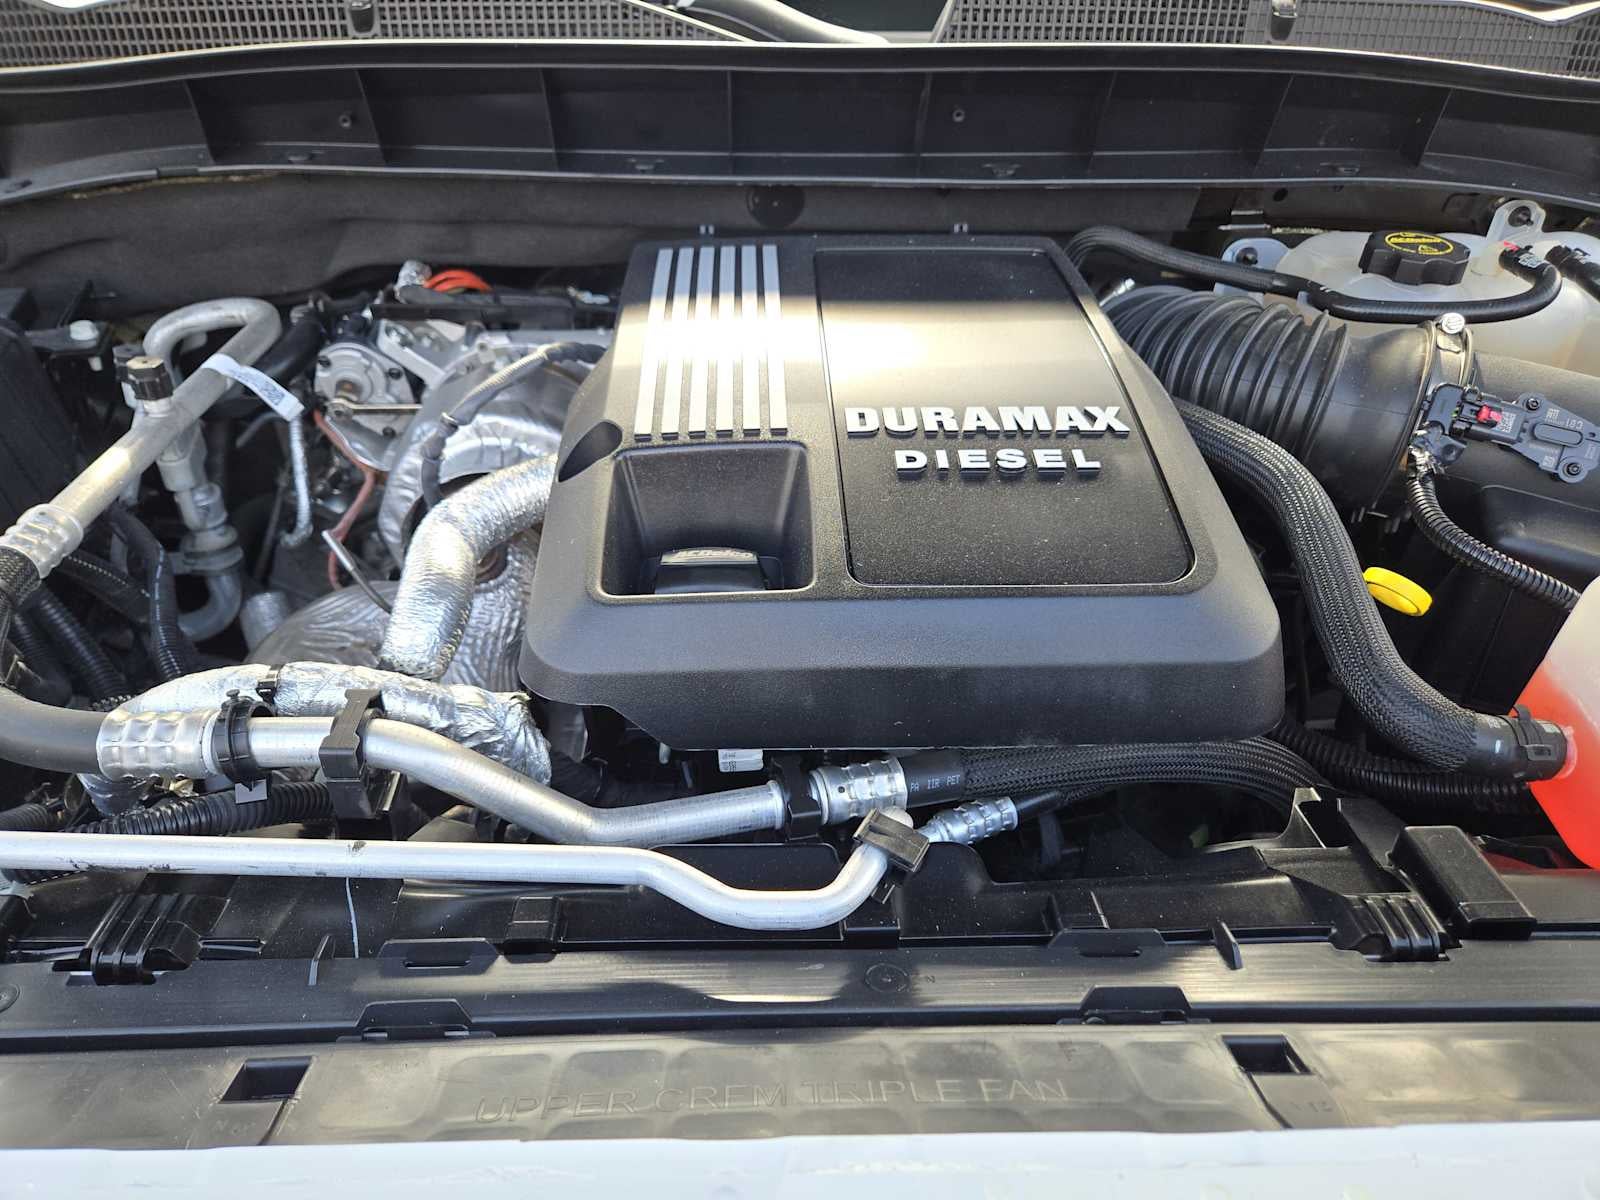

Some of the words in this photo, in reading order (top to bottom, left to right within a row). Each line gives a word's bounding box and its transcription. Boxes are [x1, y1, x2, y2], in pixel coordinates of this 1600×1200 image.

[844, 406, 1131, 436] DURAMAX
[894, 449, 1101, 475] DIESEL
[473, 1088, 637, 1122] UPPER
[800, 1078, 961, 1104] TRIPLE
[977, 1078, 1068, 1103] FAN
